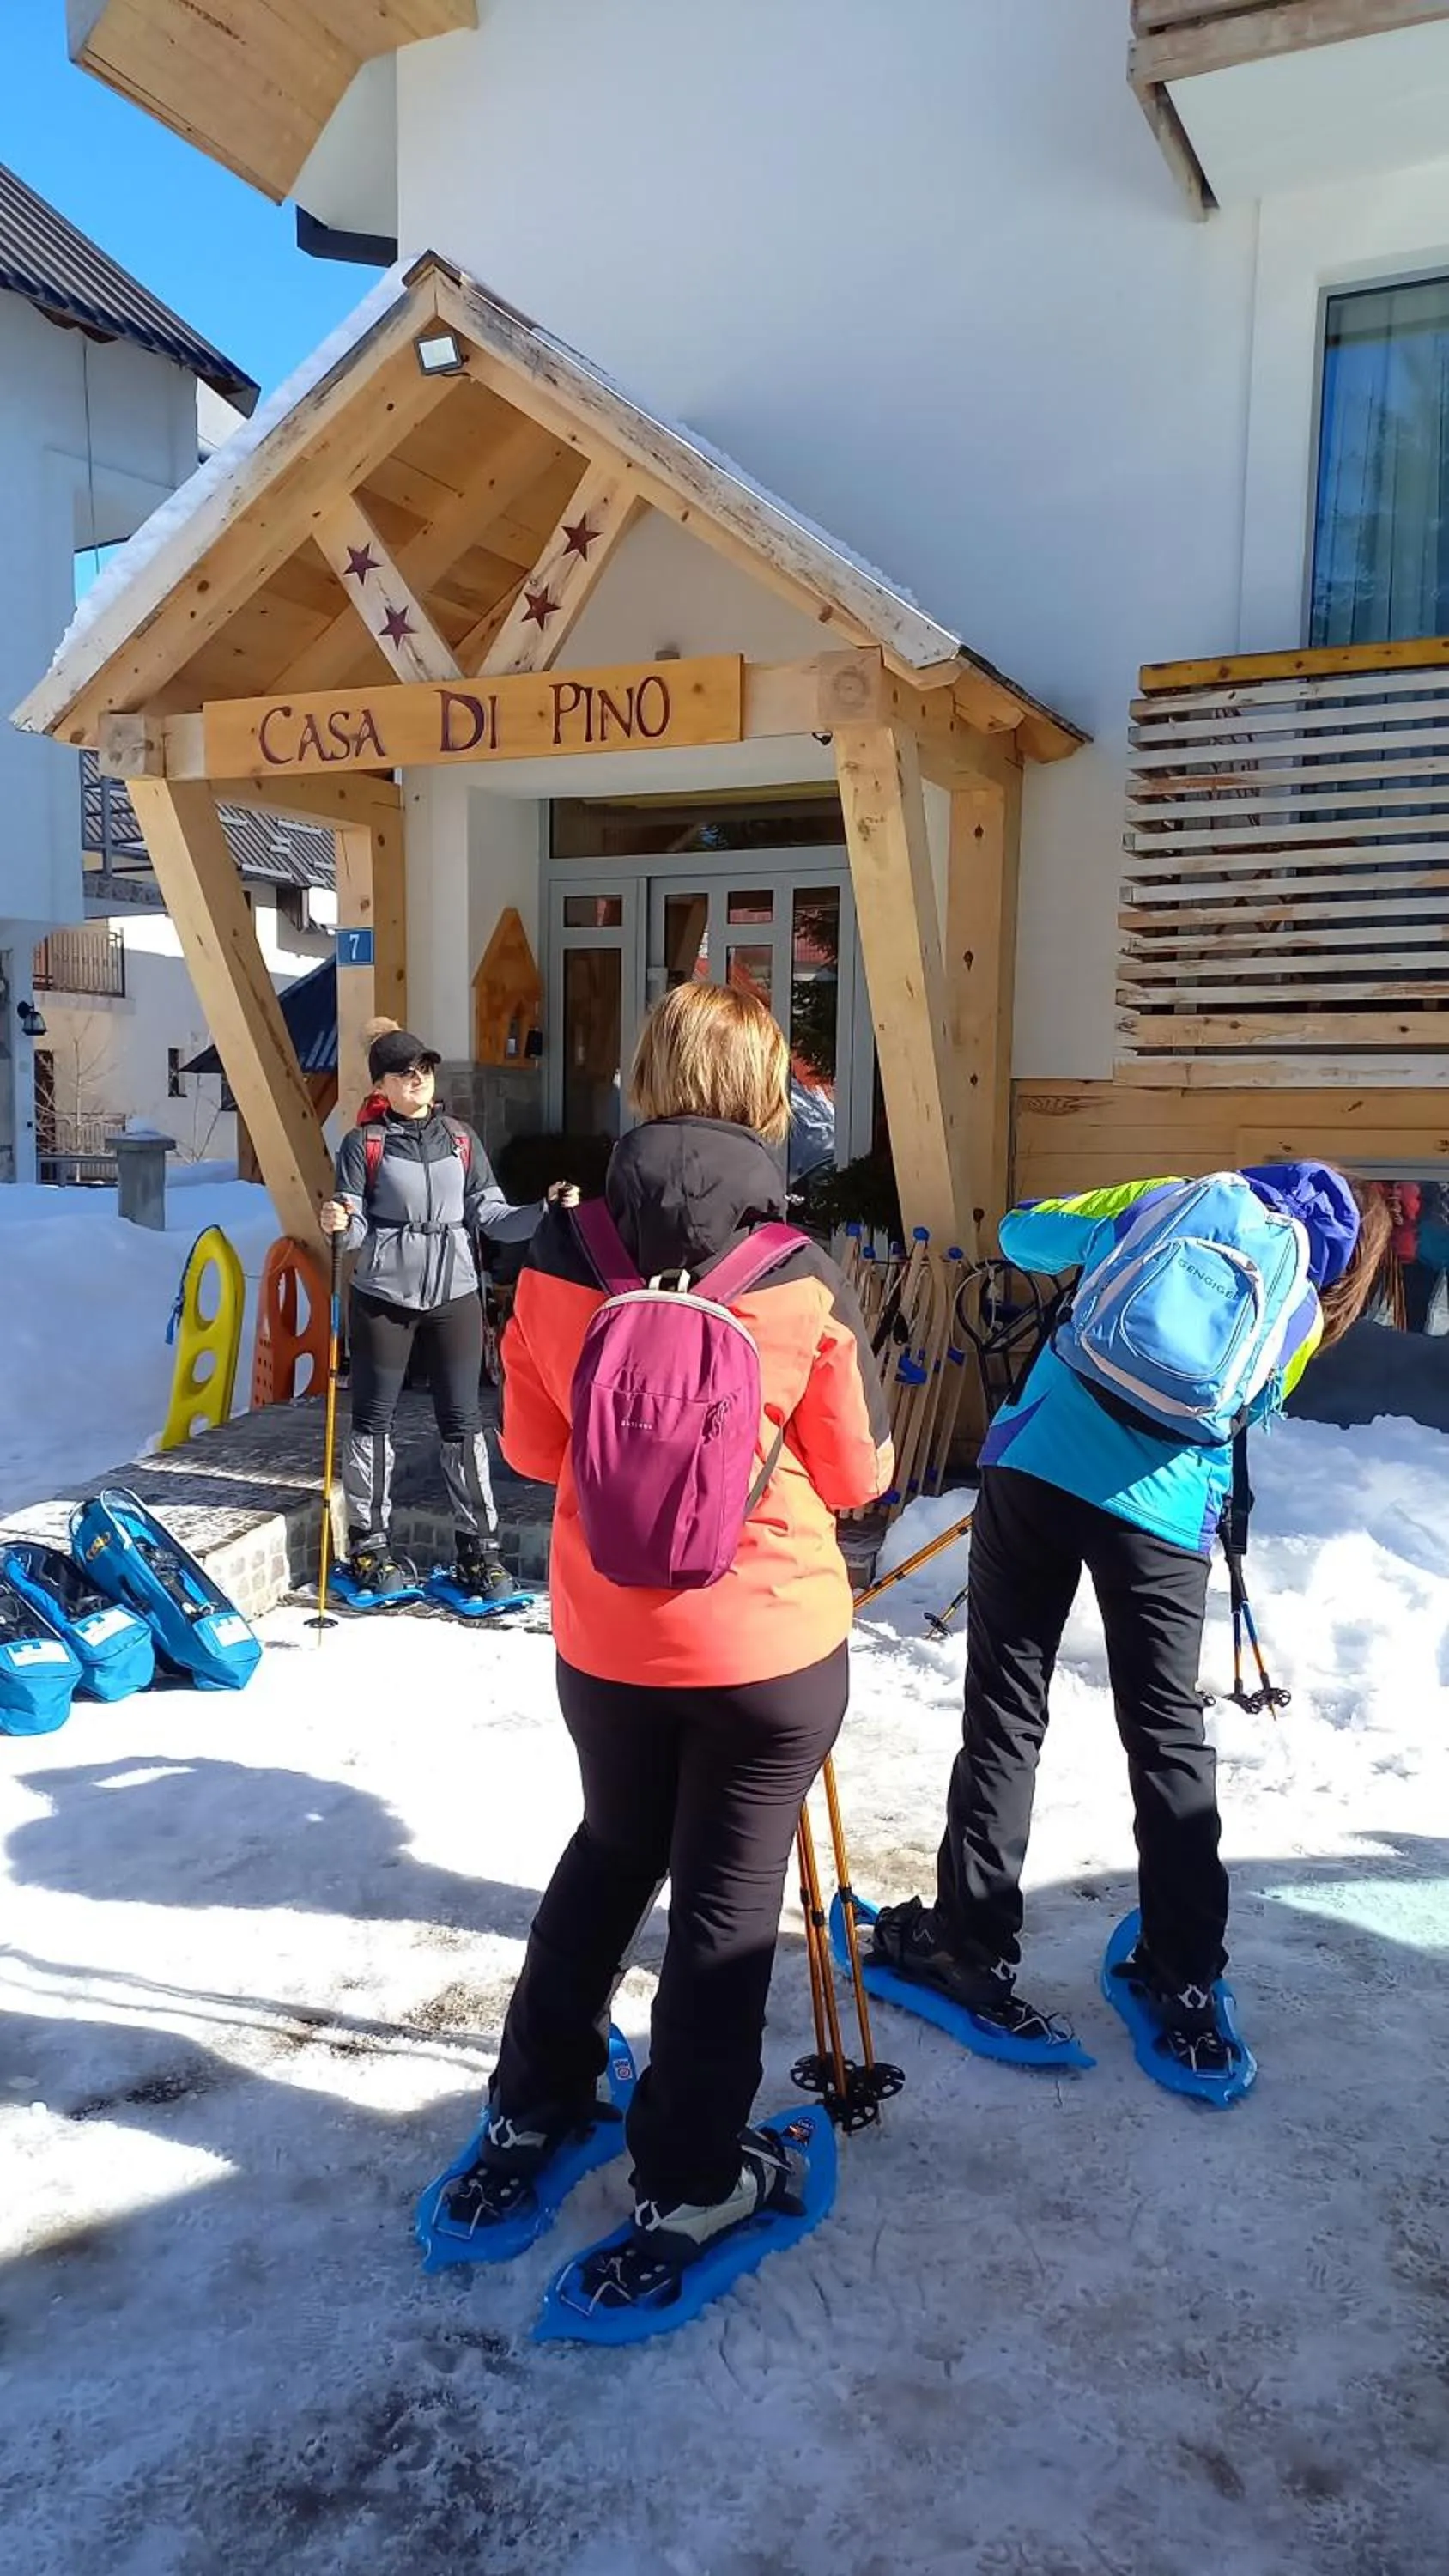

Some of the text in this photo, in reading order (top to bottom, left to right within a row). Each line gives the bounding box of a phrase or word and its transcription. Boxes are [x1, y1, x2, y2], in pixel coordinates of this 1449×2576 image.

[259, 675, 670, 764] CASA DI PINO
[349, 933, 360, 960] 7
